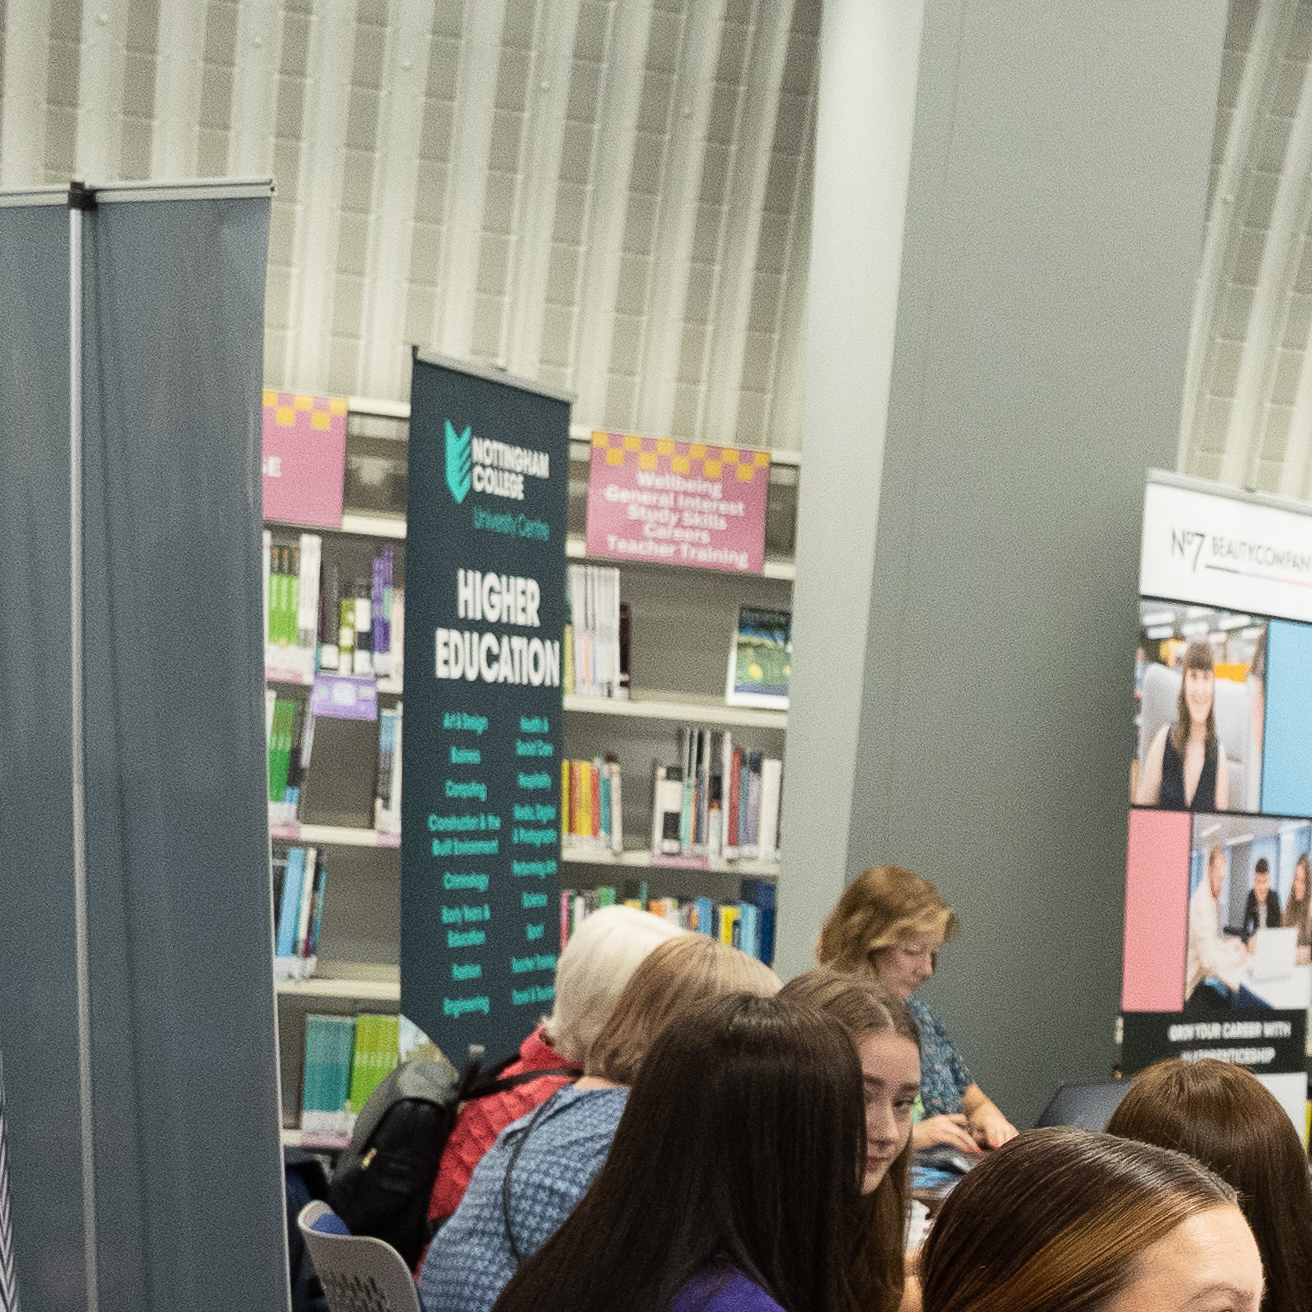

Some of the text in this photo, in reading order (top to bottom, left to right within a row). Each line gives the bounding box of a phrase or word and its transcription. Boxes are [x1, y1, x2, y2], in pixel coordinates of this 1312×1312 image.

[472, 436, 550, 480] NOTTINGHAM
[472, 466, 524, 500] COLLEGE
[605, 484, 745, 516] General Interest
[637, 471, 722, 499] Wellbeing
[627, 504, 727, 531] Study Skills
[643, 523, 710, 544] Careers
[606, 534, 749, 570] Teacher Training
[457, 568, 540, 627] HIGHER
[435, 628, 560, 687] EDUCATION
